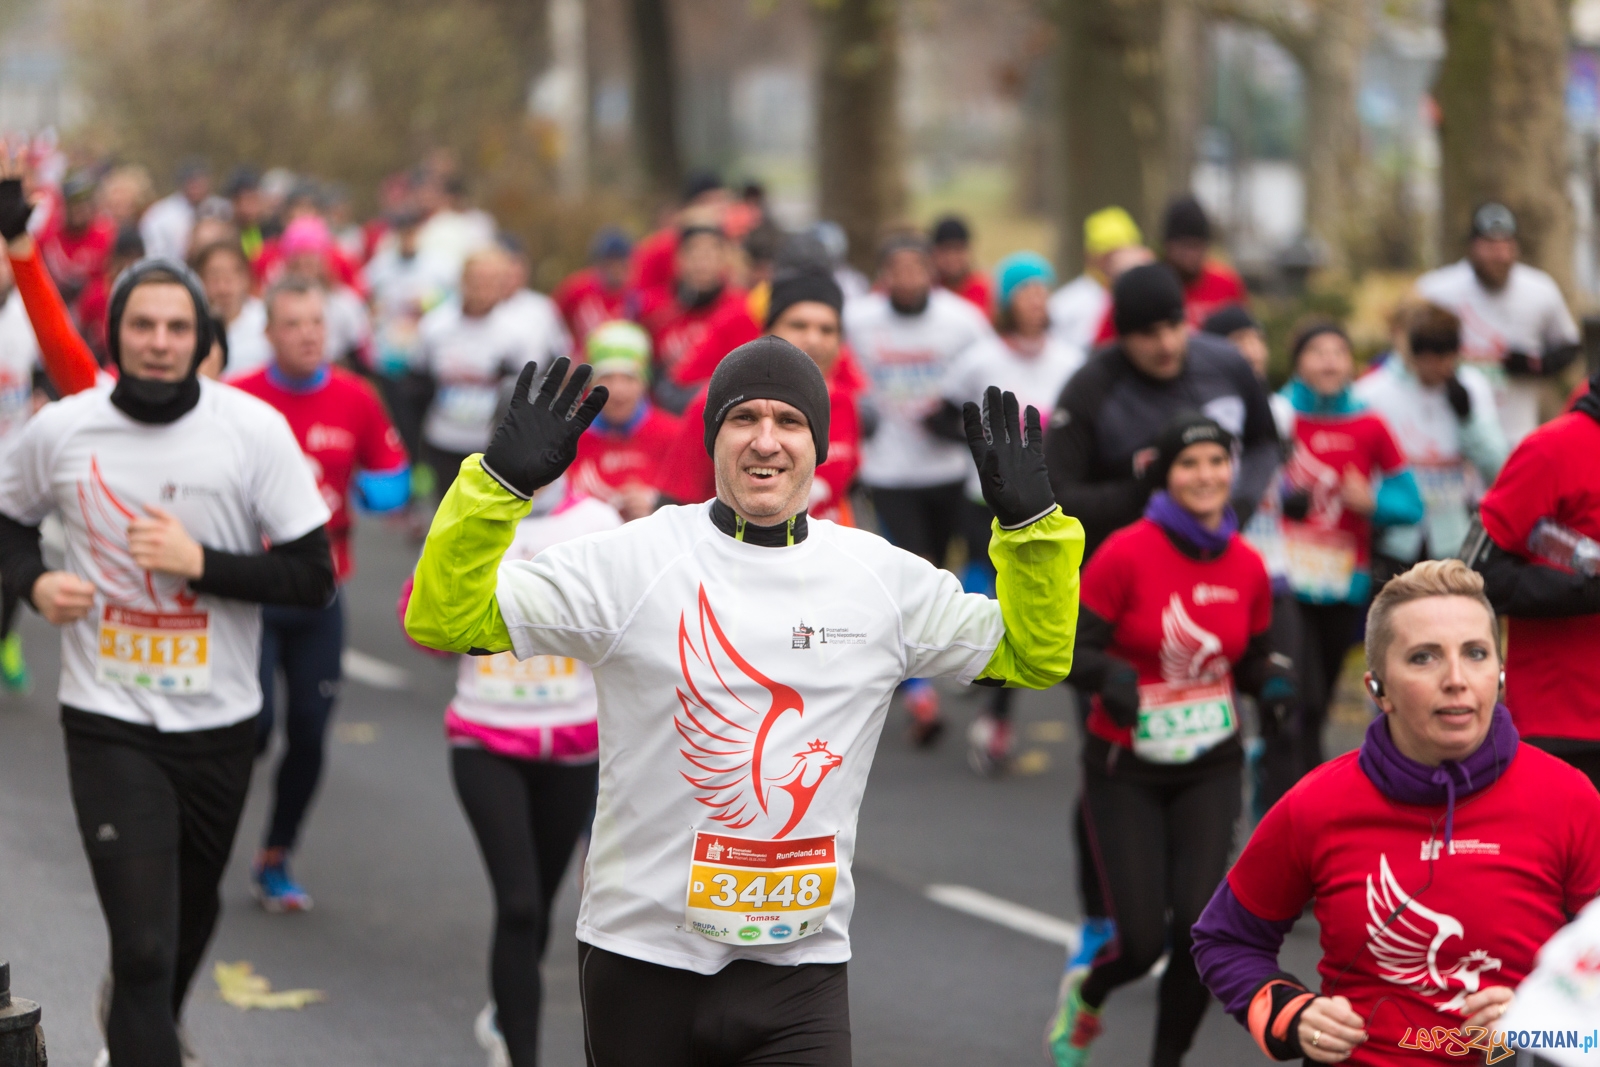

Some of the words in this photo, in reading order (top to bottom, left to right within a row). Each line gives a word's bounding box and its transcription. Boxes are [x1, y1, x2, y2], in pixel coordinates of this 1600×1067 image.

[819, 627, 827, 643] 1
[115, 632, 199, 663] 5112
[776, 849, 826, 859] RunPoland.org
[693, 880, 705, 893] D
[709, 873, 822, 909] 3448
[745, 914, 780, 922] Tomasz
[692, 921, 716, 931] GRUPA
